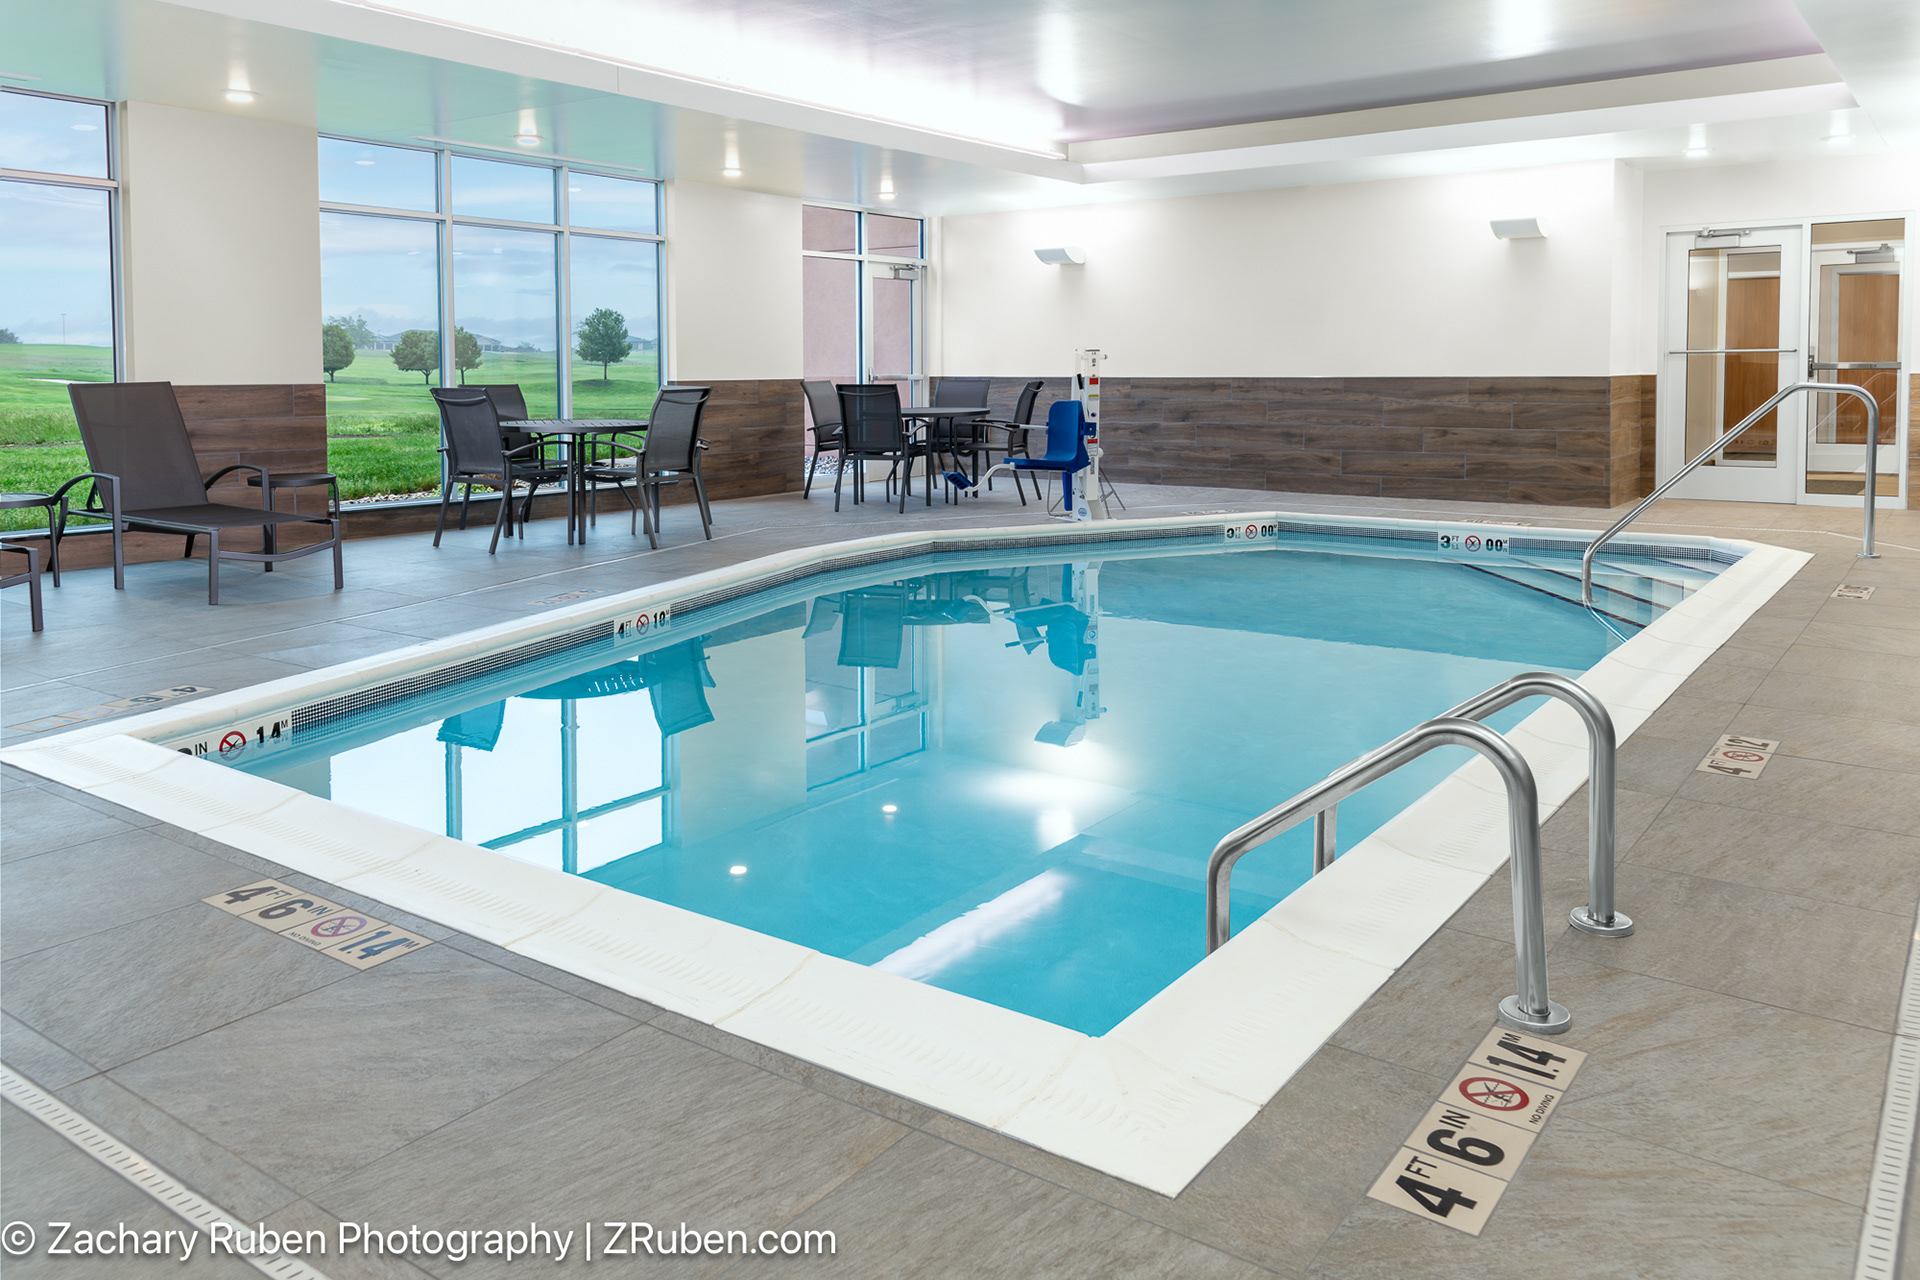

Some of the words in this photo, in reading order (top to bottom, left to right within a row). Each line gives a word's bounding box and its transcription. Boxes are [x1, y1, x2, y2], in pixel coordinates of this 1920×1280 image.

[194, 741, 209, 756] IN
[1706, 764, 1753, 776] 4
[223, 885, 279, 905] 4
[266, 889, 293, 901] FT
[257, 898, 315, 920] 6
[305, 904, 334, 917] IN
[337, 930, 411, 961] 1.4
[401, 937, 421, 950] M
[1501, 1032, 1523, 1045] M
[1485, 1039, 1568, 1081] 1.4
[1438, 1109, 1472, 1130] IN
[1528, 1112, 1542, 1126] NO
[1535, 1094, 1555, 1115] DIVING
[1426, 1128, 1506, 1167] 6
[1404, 1155, 1438, 1180] FT
[1394, 1174, 1478, 1218] 4
